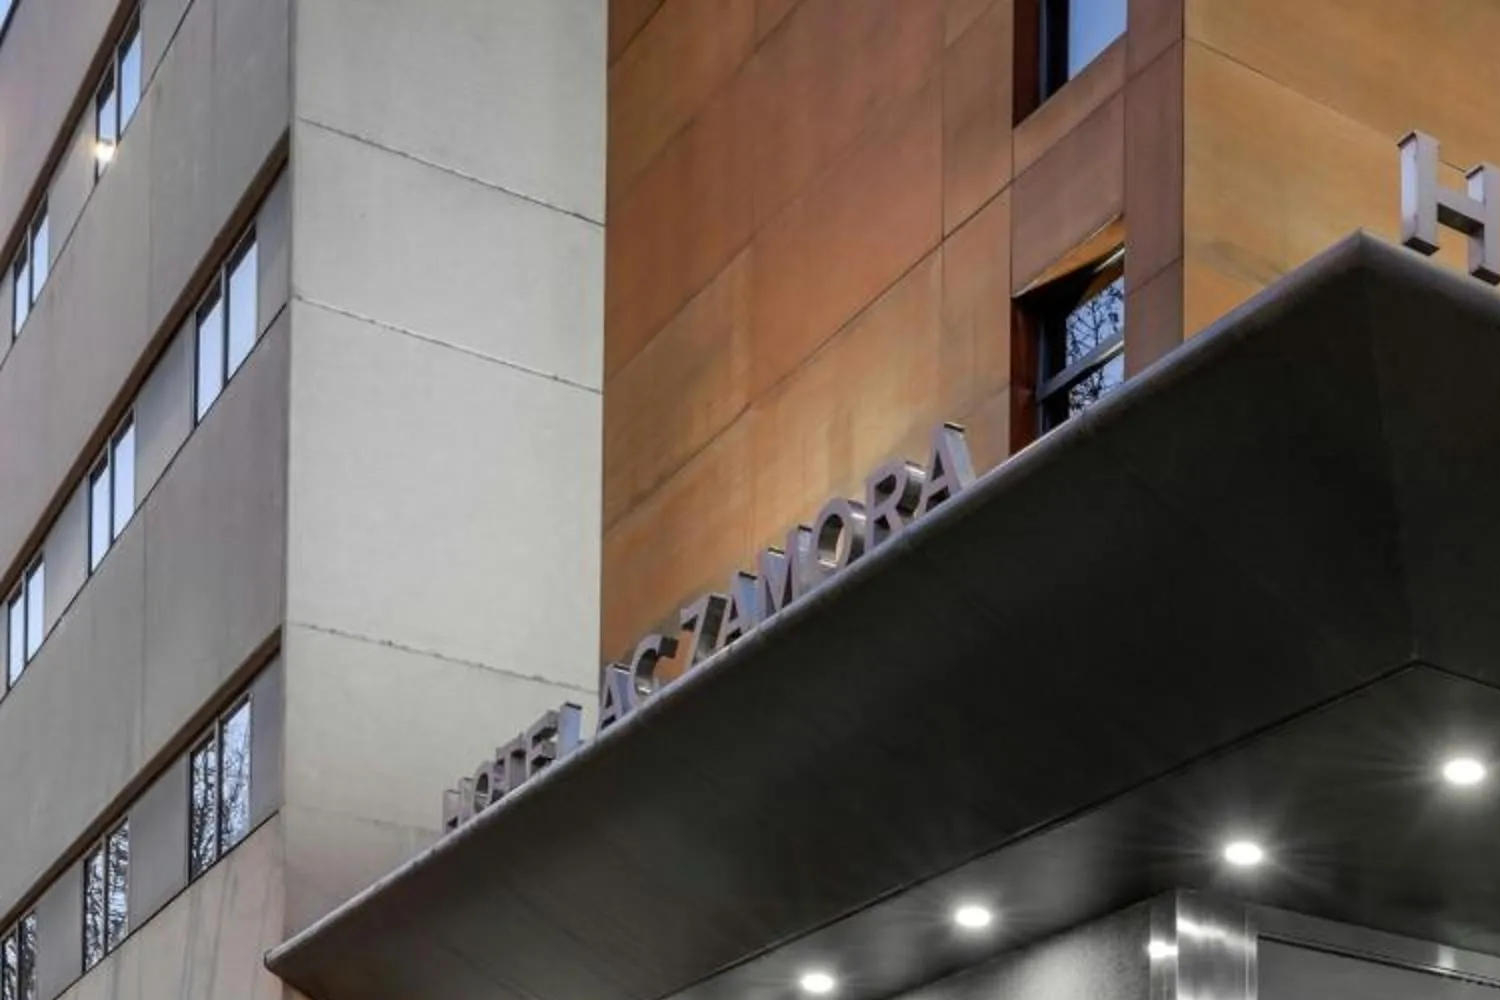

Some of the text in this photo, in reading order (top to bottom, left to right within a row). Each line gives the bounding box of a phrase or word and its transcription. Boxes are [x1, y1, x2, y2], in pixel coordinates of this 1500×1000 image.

[442, 421, 977, 834] HOTEL AC ZAMORA
